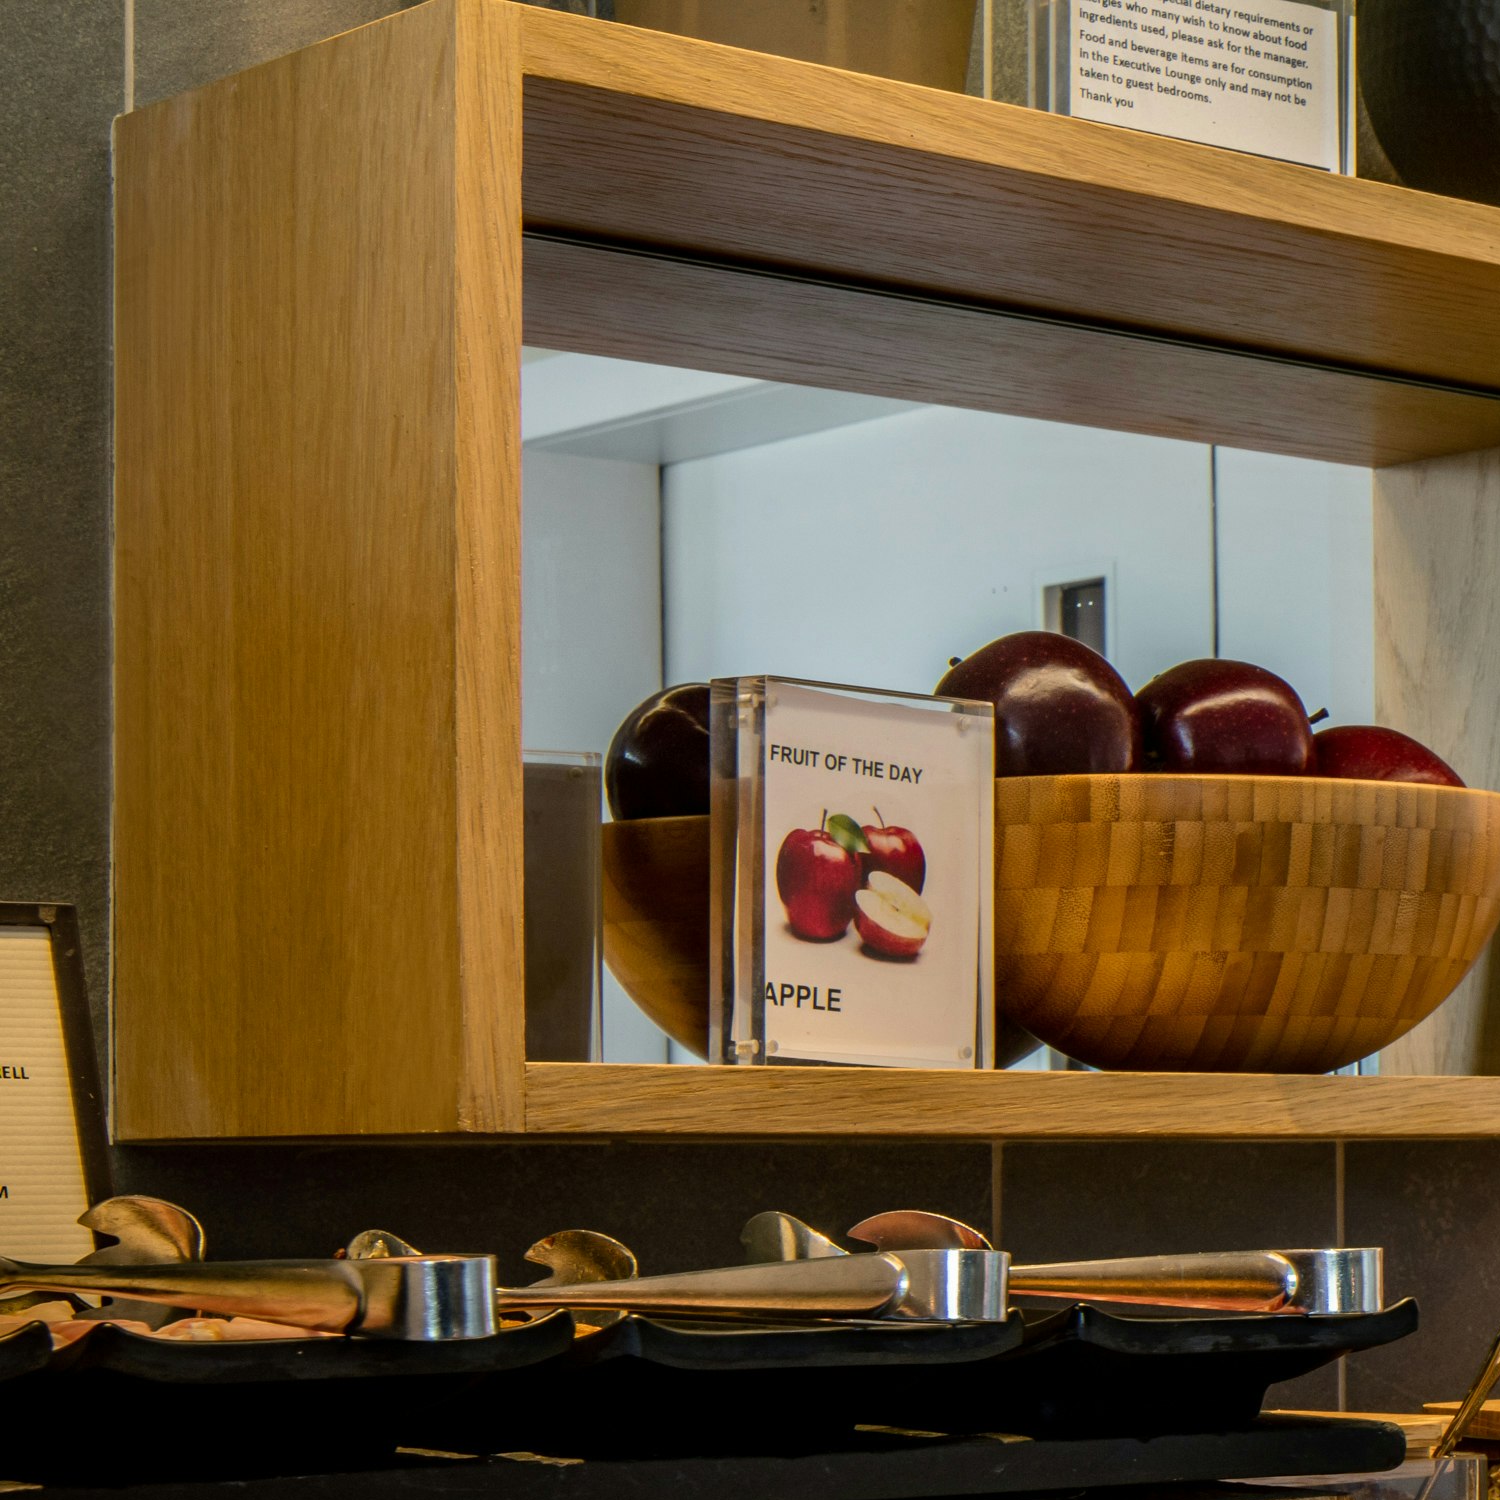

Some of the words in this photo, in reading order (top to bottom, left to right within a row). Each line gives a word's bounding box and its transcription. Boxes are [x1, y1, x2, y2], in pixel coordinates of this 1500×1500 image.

[1126, 2, 1148, 14] who
[1151, 9, 1180, 24] many
[1183, 15, 1206, 28] wish
[1208, 20, 1220, 31] to
[1223, 22, 1250, 38] know
[1253, 31, 1282, 45] about
[1285, 37, 1308, 51] food
[1195, 0, 1231, 19] dietary
[1234, 10, 1301, 33] requirements
[1303, 26, 1314, 35] or
[1079, 8, 1138, 30] ingredients
[1141, 23, 1168, 39] used,
[1172, 30, 1204, 45] please
[1207, 39, 1224, 49] ask
[1227, 41, 1241, 53] for
[1245, 46, 1261, 58] the
[1264, 51, 1309, 69] manager.
[1079, 48, 1089, 59] in
[1092, 51, 1109, 63] the
[1113, 55, 1161, 74] Executive
[1165, 67, 1201, 85] Lounge
[1205, 76, 1226, 91] only
[1229, 82, 1248, 93] and
[1251, 87, 1272, 101] may
[1275, 92, 1291, 103] not
[1294, 94, 1306, 106] be
[1080, 30, 1106, 44] Food
[1108, 38, 1128, 49] and
[1131, 40, 1178, 61] beverage
[1181, 52, 1209, 67] items
[1212, 60, 1228, 71] are
[1231, 62, 1245, 75] for
[1248, 69, 1312, 90] consumption
[1080, 67, 1109, 82] taken
[1112, 73, 1123, 85] to
[1126, 78, 1154, 92] guest
[1157, 82, 1212, 104] bedrooms.
[1080, 88, 1112, 104] Thank
[1115, 97, 1134, 108] you
[770, 744, 820, 768] FRUIT
[824, 753, 847, 772] OF
[852, 758, 884, 778] THE
[889, 764, 923, 785] DAY
[765, 982, 841, 1012] APPLE
[0, 1066, 29, 1080] ELL
